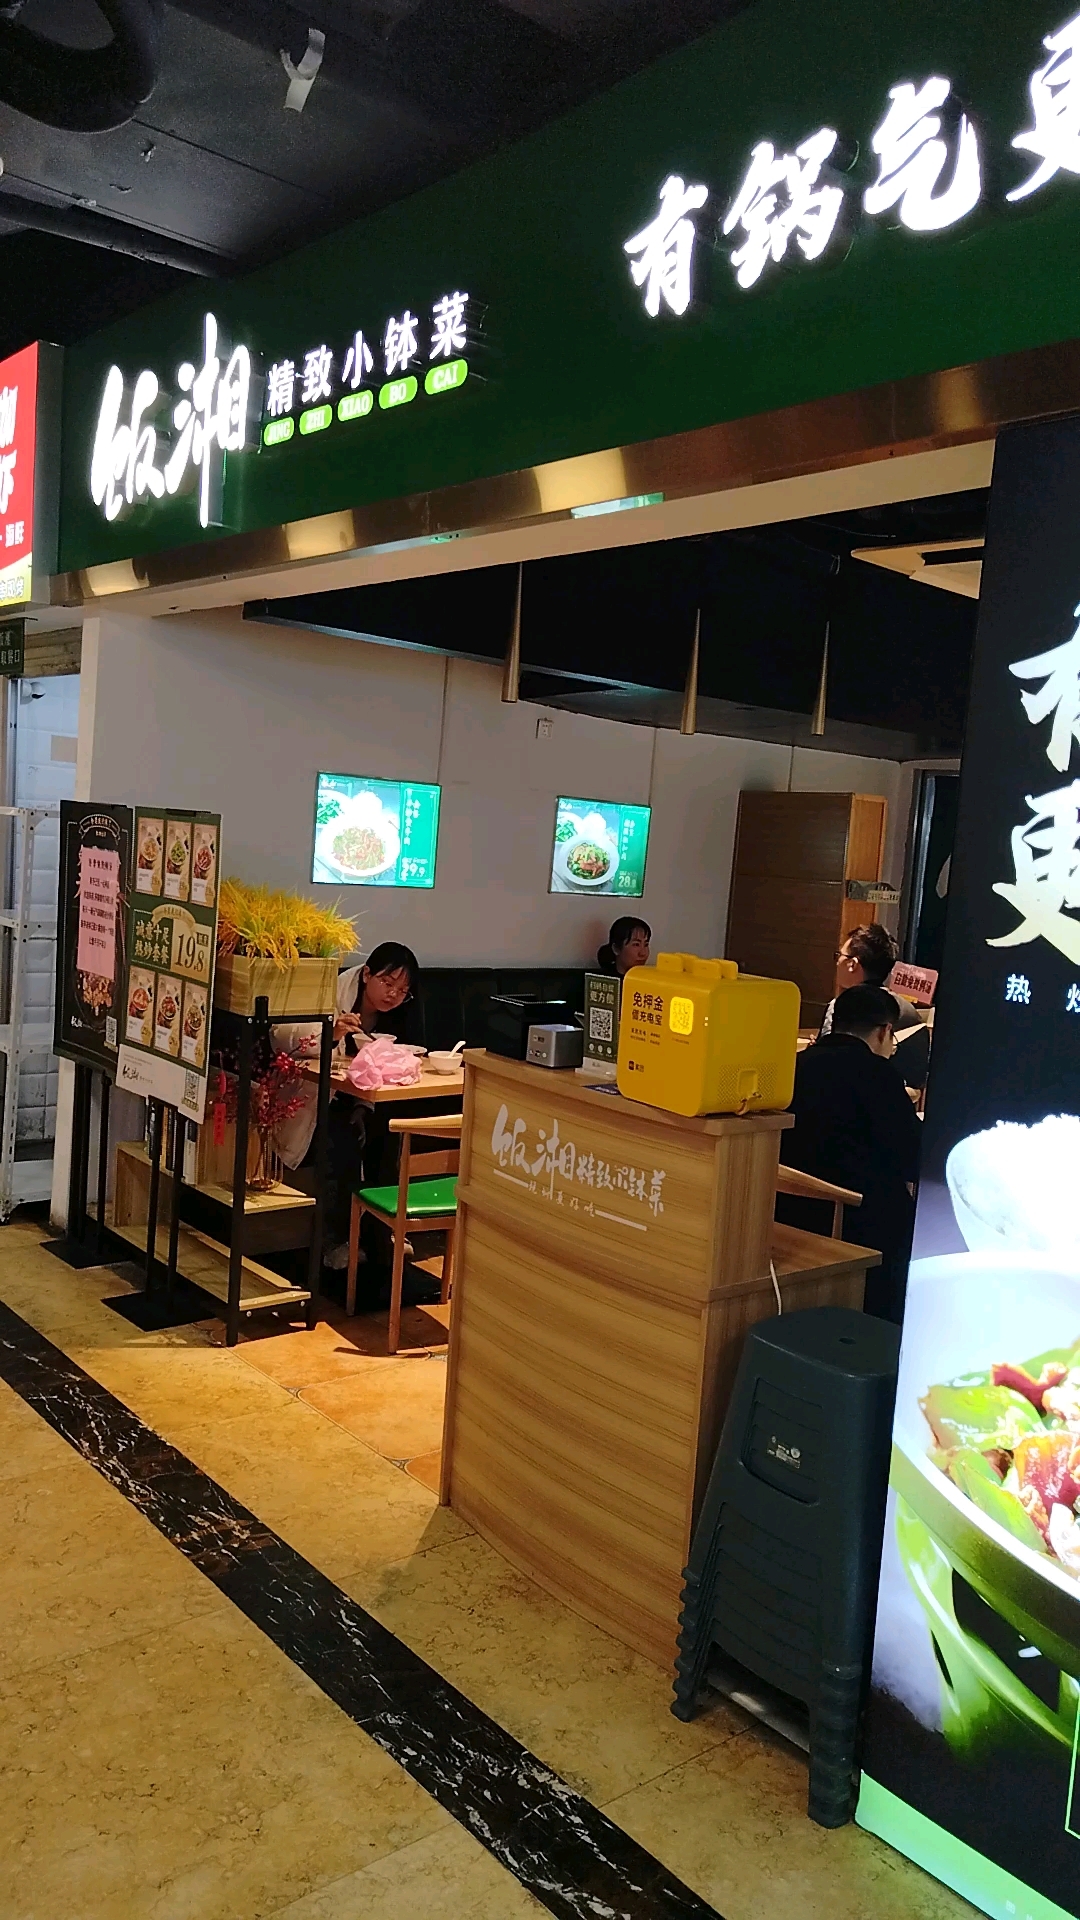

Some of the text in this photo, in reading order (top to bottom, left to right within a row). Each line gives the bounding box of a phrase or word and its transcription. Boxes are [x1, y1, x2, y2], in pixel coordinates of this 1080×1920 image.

[267, 291, 469, 416] 精致小钵菜
[91, 312, 250, 528] 饭湘
[268, 363, 458, 443] JING ZHI XIAO BO CAI
[175, 934, 204, 973] 19.8
[590, 990, 615, 1004] 更方便
[632, 1009, 662, 1026] 借充电宝
[633, 992, 663, 1011] 免押金
[576, 1152, 666, 1217] 精致小钵菜
